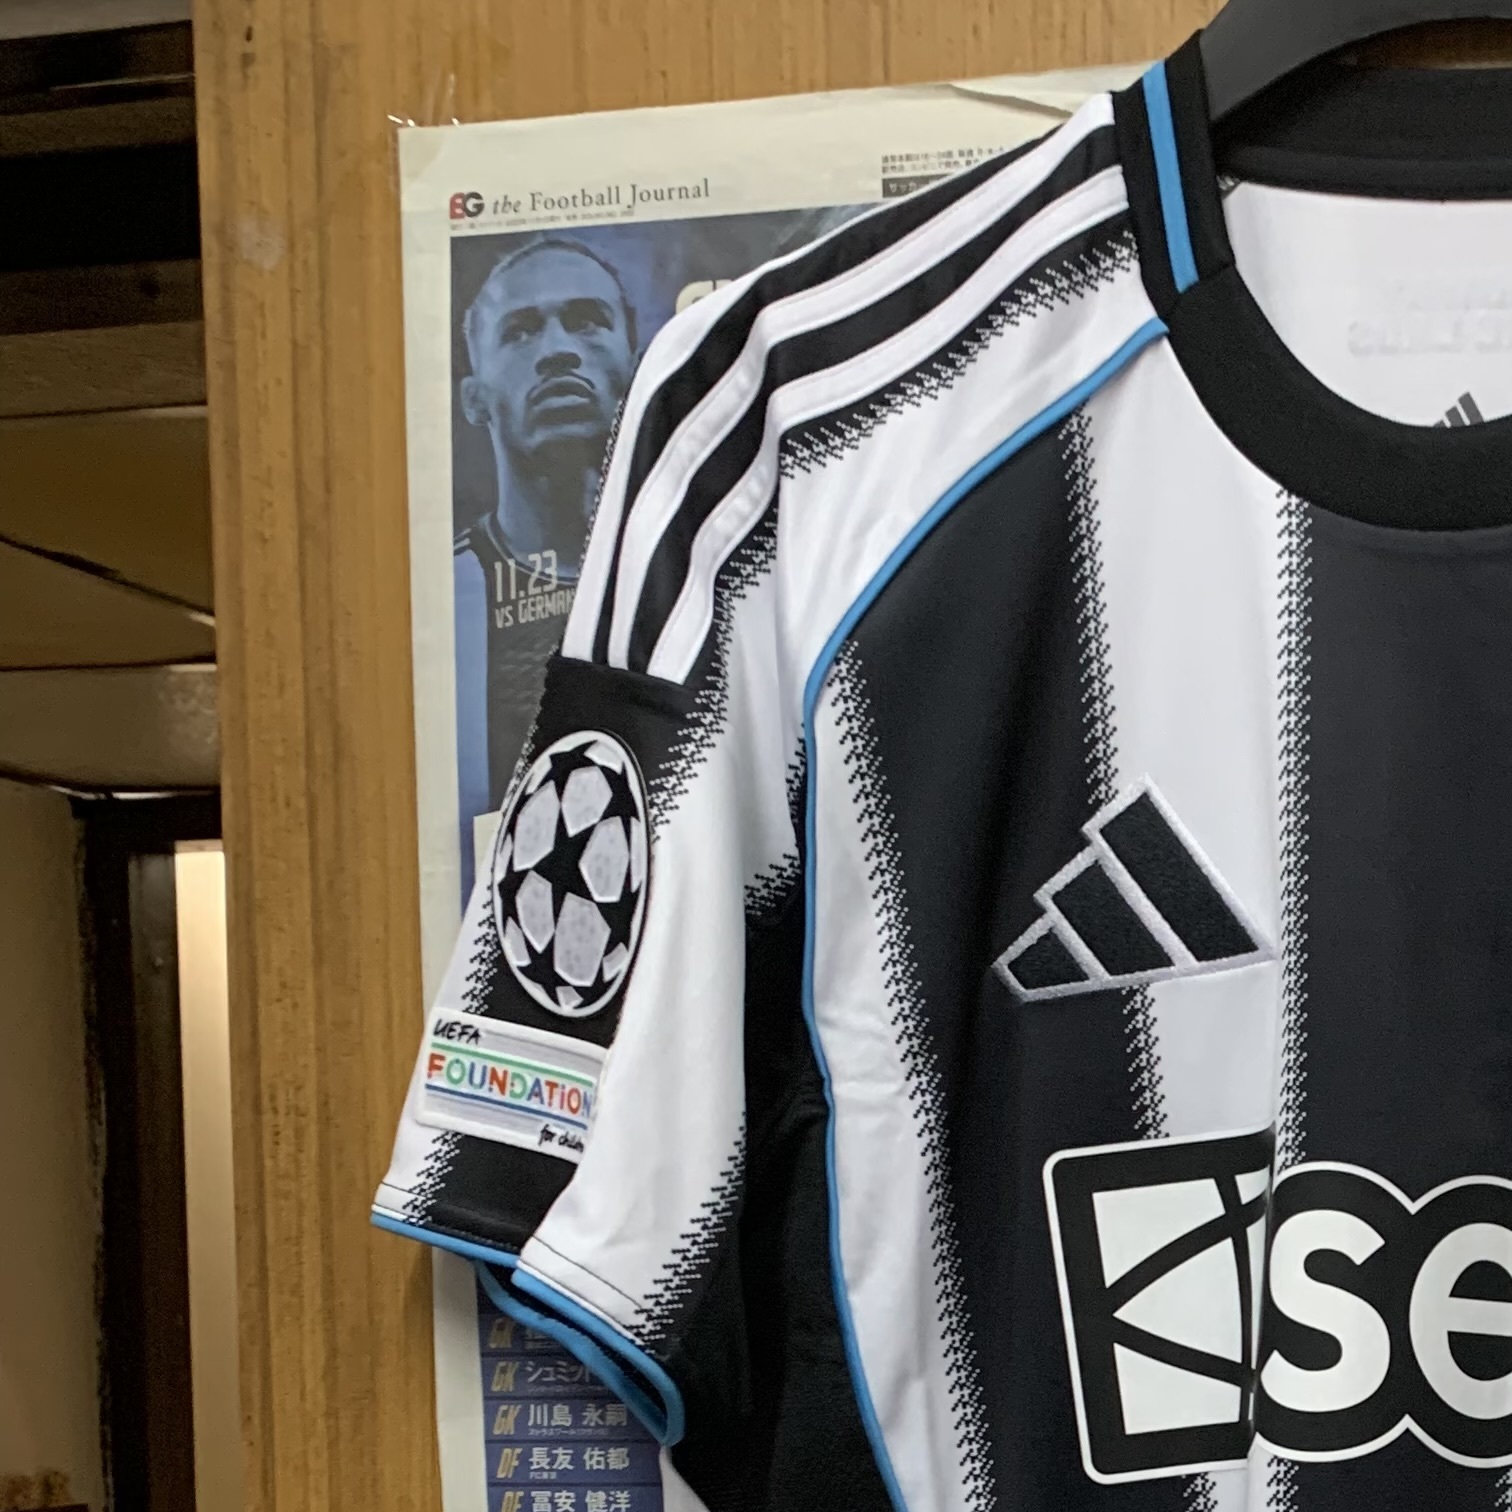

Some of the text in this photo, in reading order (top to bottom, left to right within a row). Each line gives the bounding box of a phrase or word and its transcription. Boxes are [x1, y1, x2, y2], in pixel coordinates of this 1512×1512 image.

[492, 194, 522, 215] the
[529, 185, 622, 212] Football
[626, 177, 710, 209] Journal
[494, 549, 558, 603] 11.23
[495, 605, 514, 629] VS
[433, 1018, 482, 1045] UEFA
[527, 1403, 573, 1427] 川島
[529, 1446, 574, 1471] 長友
[583, 1446, 630, 1471] 佑都
